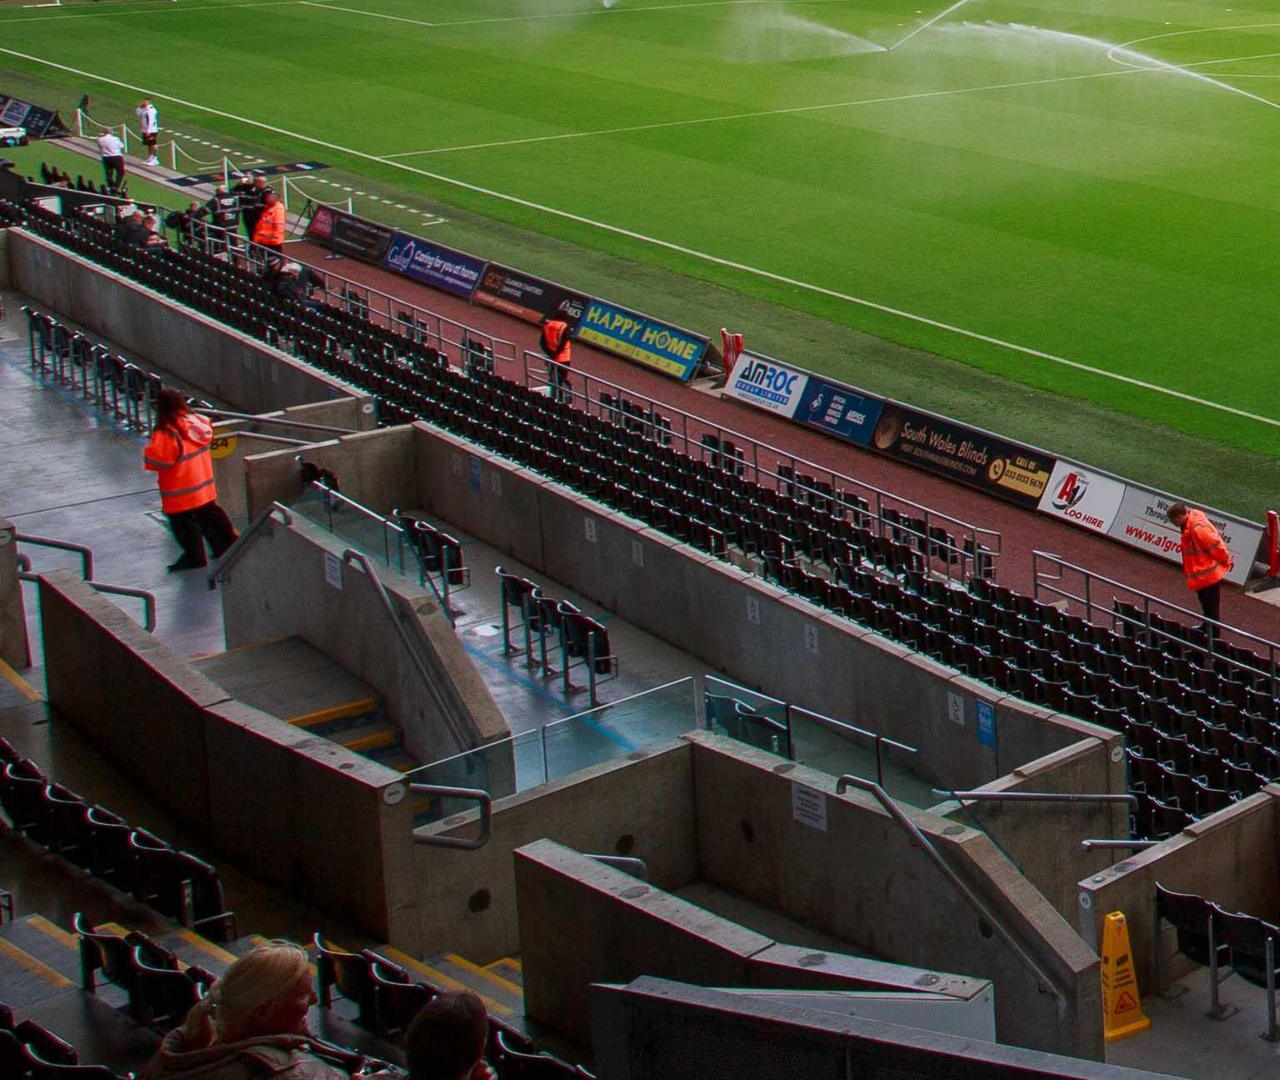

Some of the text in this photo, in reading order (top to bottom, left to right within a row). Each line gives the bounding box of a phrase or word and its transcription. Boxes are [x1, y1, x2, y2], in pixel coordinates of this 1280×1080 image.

[461, 263, 479, 281] home
[586, 306, 643, 339] HAPPY
[640, 326, 698, 360] HOME
[739, 360, 799, 396] AMROC
[901, 421, 989, 466] South Wales Blinds
[1064, 506, 1105, 529] LOO HIRE
[1124, 524, 1182, 554] www.a1gro
